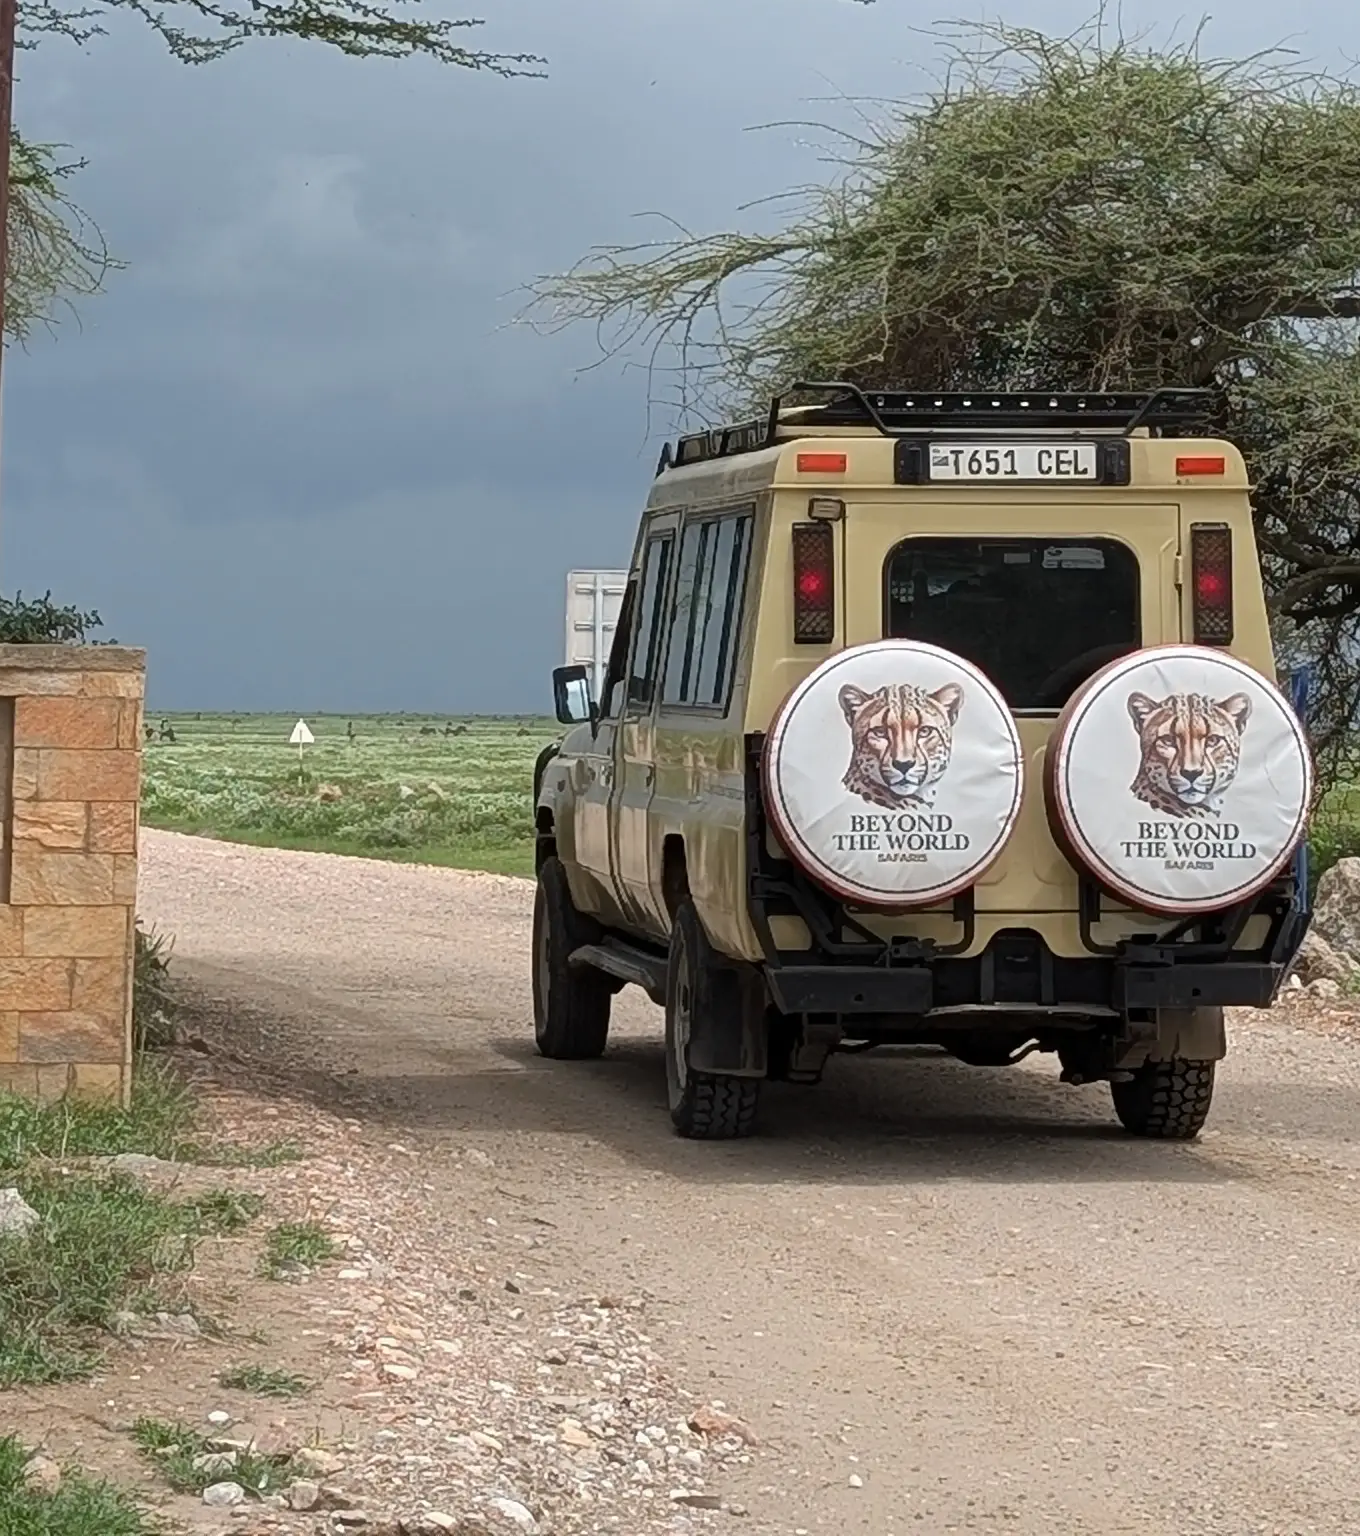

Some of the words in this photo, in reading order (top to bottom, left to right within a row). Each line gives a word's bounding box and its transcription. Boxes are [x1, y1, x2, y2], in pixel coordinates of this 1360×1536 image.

[950, 450, 1018, 475] T651
[1038, 450, 1088, 475] CEL
[850, 814, 953, 833] BEYOND
[1138, 821, 1240, 841] BEYOND
[833, 834, 880, 851] THE
[885, 833, 970, 851] WORLD
[1120, 841, 1167, 859] THE
[1173, 841, 1257, 859] WORLD
[877, 853, 928, 863] SAFARIS
